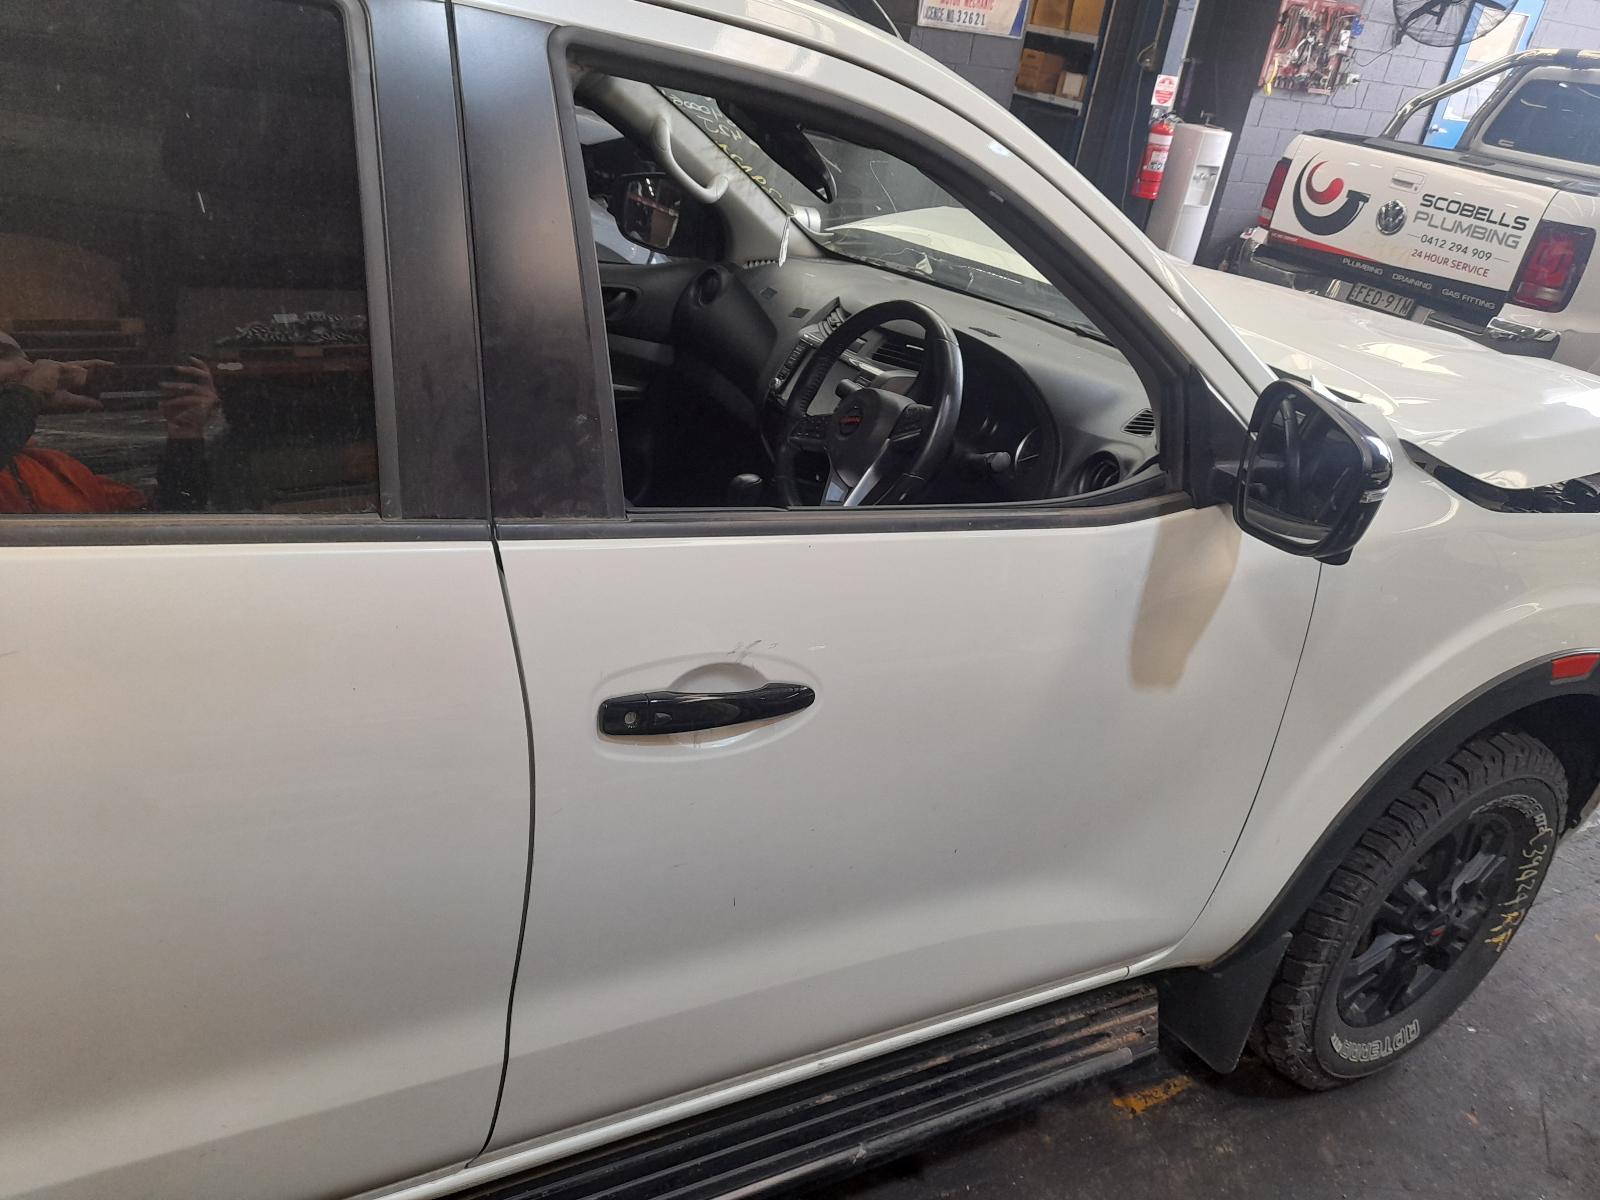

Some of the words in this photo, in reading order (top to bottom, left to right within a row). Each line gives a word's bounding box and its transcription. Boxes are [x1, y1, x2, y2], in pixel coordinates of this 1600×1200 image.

[957, 10, 986, 26] 32621
[1420, 193, 1530, 231] SCOBELLS
[1413, 211, 1522, 249] PLUMBING
[1411, 249, 1423, 258] 24
[1423, 252, 1449, 266] HOUR
[1450, 259, 1490, 278] SERVICE
[1420, 234, 1447, 249] 0412
[1448, 242, 1468, 255] 294
[1471, 248, 1492, 261] 909
[1342, 257, 1384, 276] PLUMBING
[1392, 273, 1433, 291] DRAINING
[1441, 288, 1460, 299] GAS
[1461, 294, 1496, 310] FITTING
